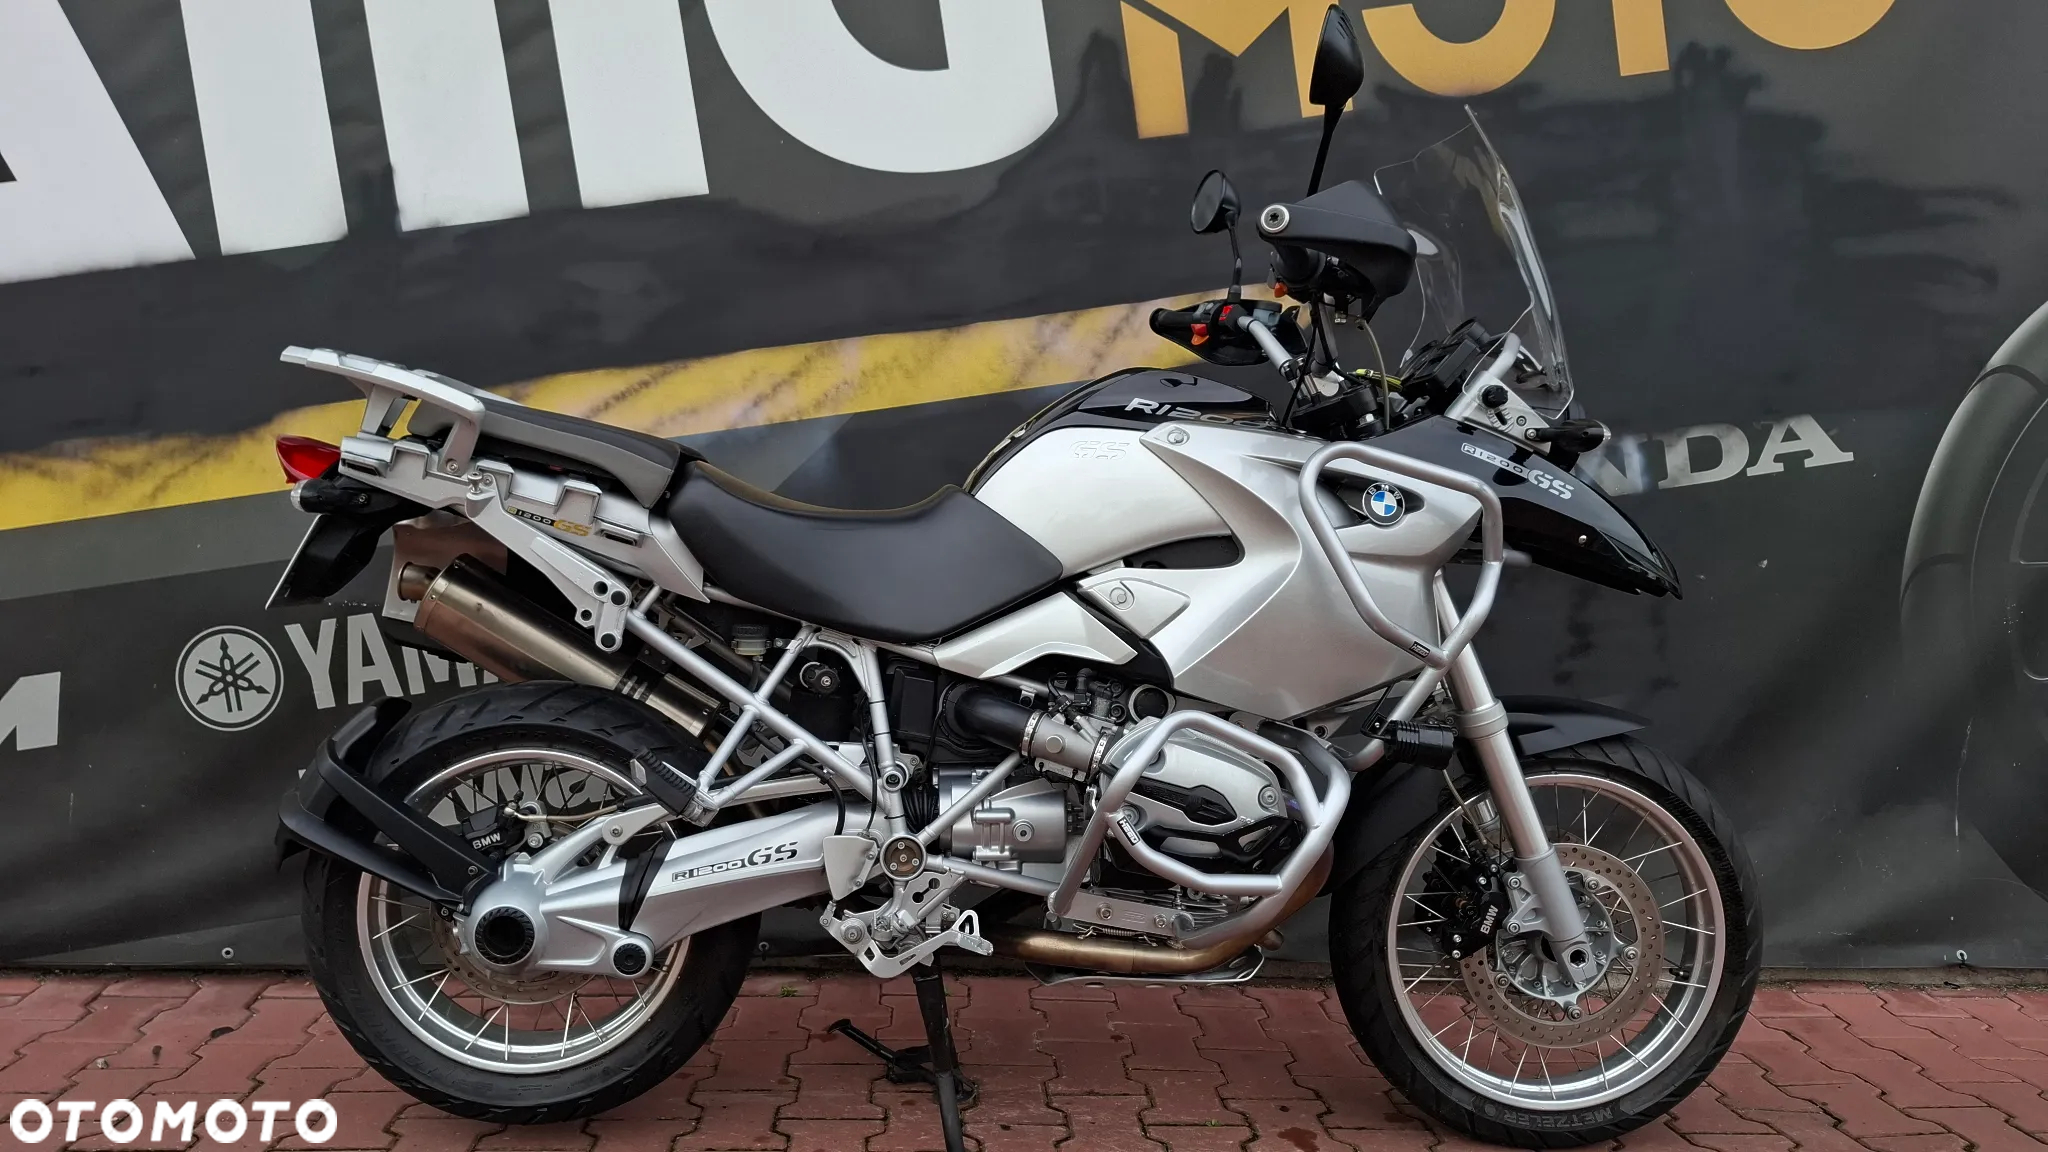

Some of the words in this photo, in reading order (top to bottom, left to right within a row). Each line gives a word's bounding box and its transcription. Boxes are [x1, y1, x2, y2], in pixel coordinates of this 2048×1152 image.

[1575, 414, 1854, 497] NDA
[473, 833, 500, 849] BMW
[1480, 904, 1499, 935] BMW
[1503, 1107, 1613, 1128] METZELER
